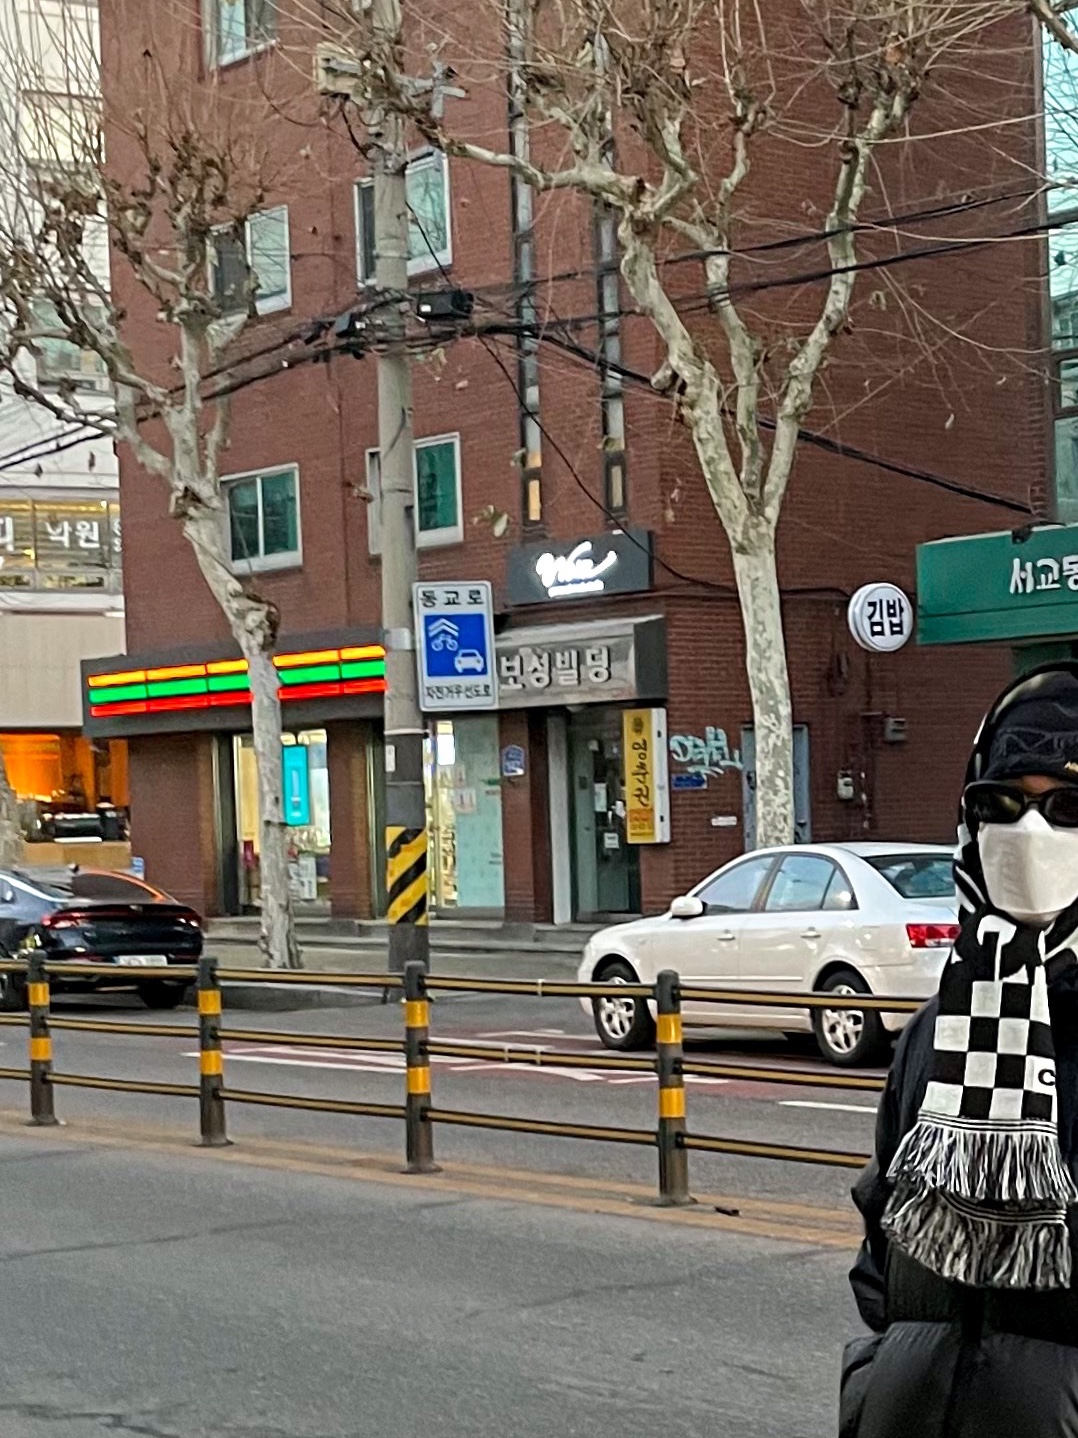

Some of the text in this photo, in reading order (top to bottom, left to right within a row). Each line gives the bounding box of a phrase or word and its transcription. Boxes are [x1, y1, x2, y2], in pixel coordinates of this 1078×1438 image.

[420, 589, 485, 608] 동교로
[867, 598, 904, 638] 김밥
[500, 645, 611, 690] 보성빌딩
